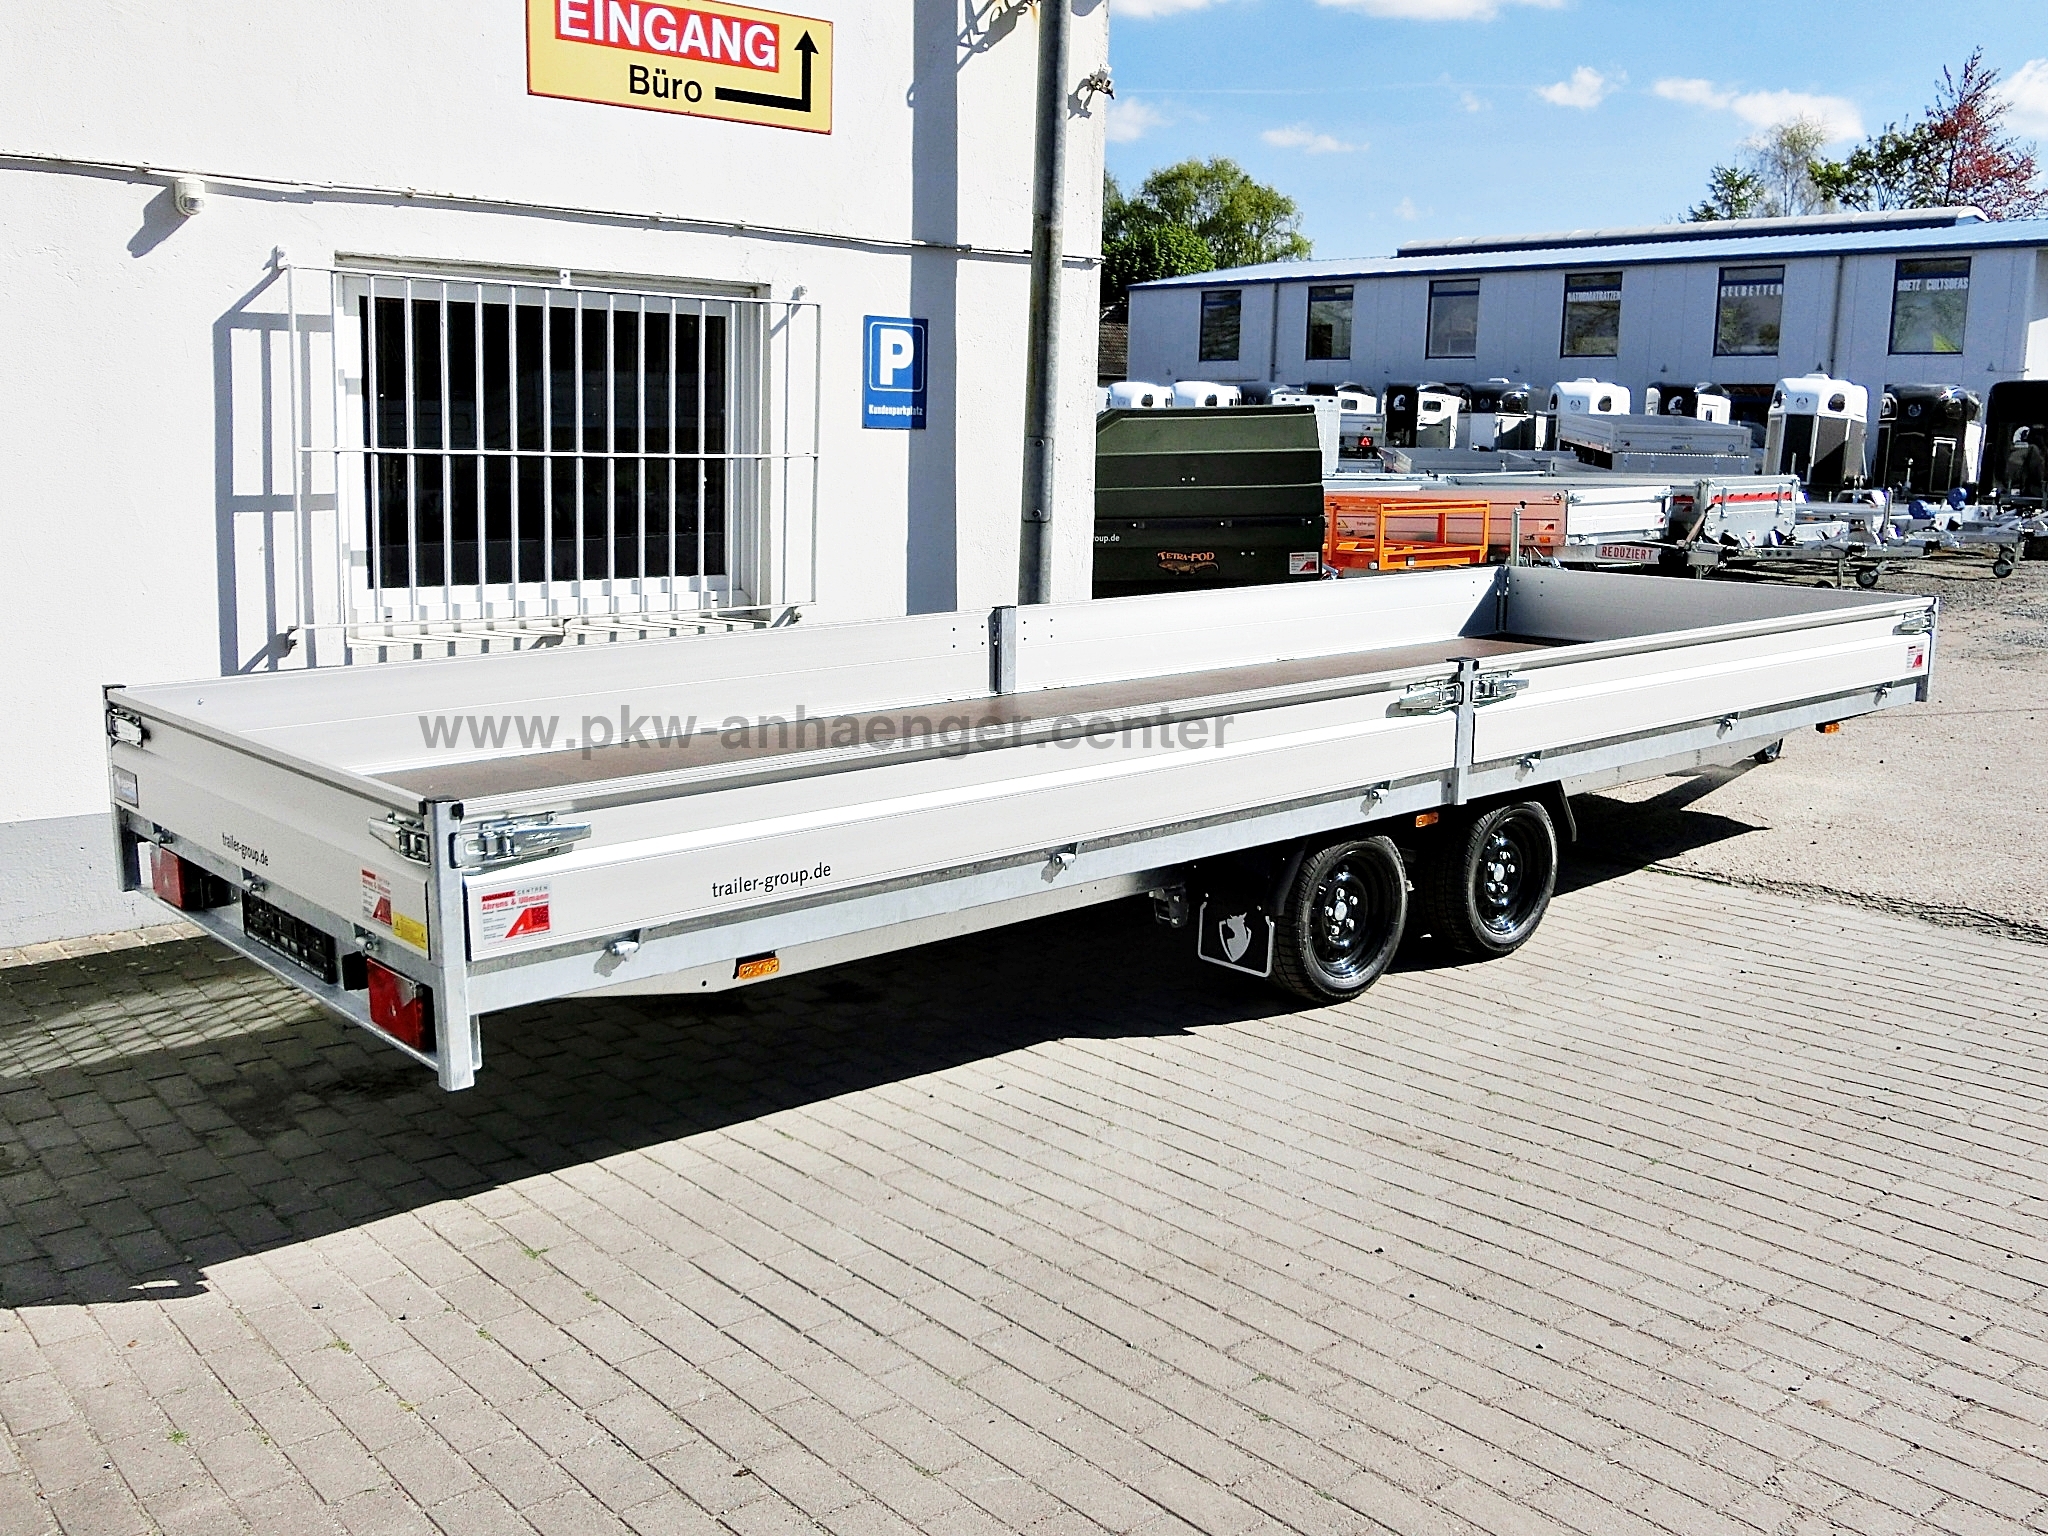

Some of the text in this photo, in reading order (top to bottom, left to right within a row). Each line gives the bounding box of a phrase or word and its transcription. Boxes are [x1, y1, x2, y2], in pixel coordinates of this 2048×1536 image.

[559, 0, 776, 68] EINGANG
[629, 64, 703, 103] Büro
[880, 328, 914, 385] P
[1601, 546, 1653, 560] REDUZIERT
[222, 832, 269, 866] trailer-group.de
[712, 861, 831, 898] trailer-group.de
